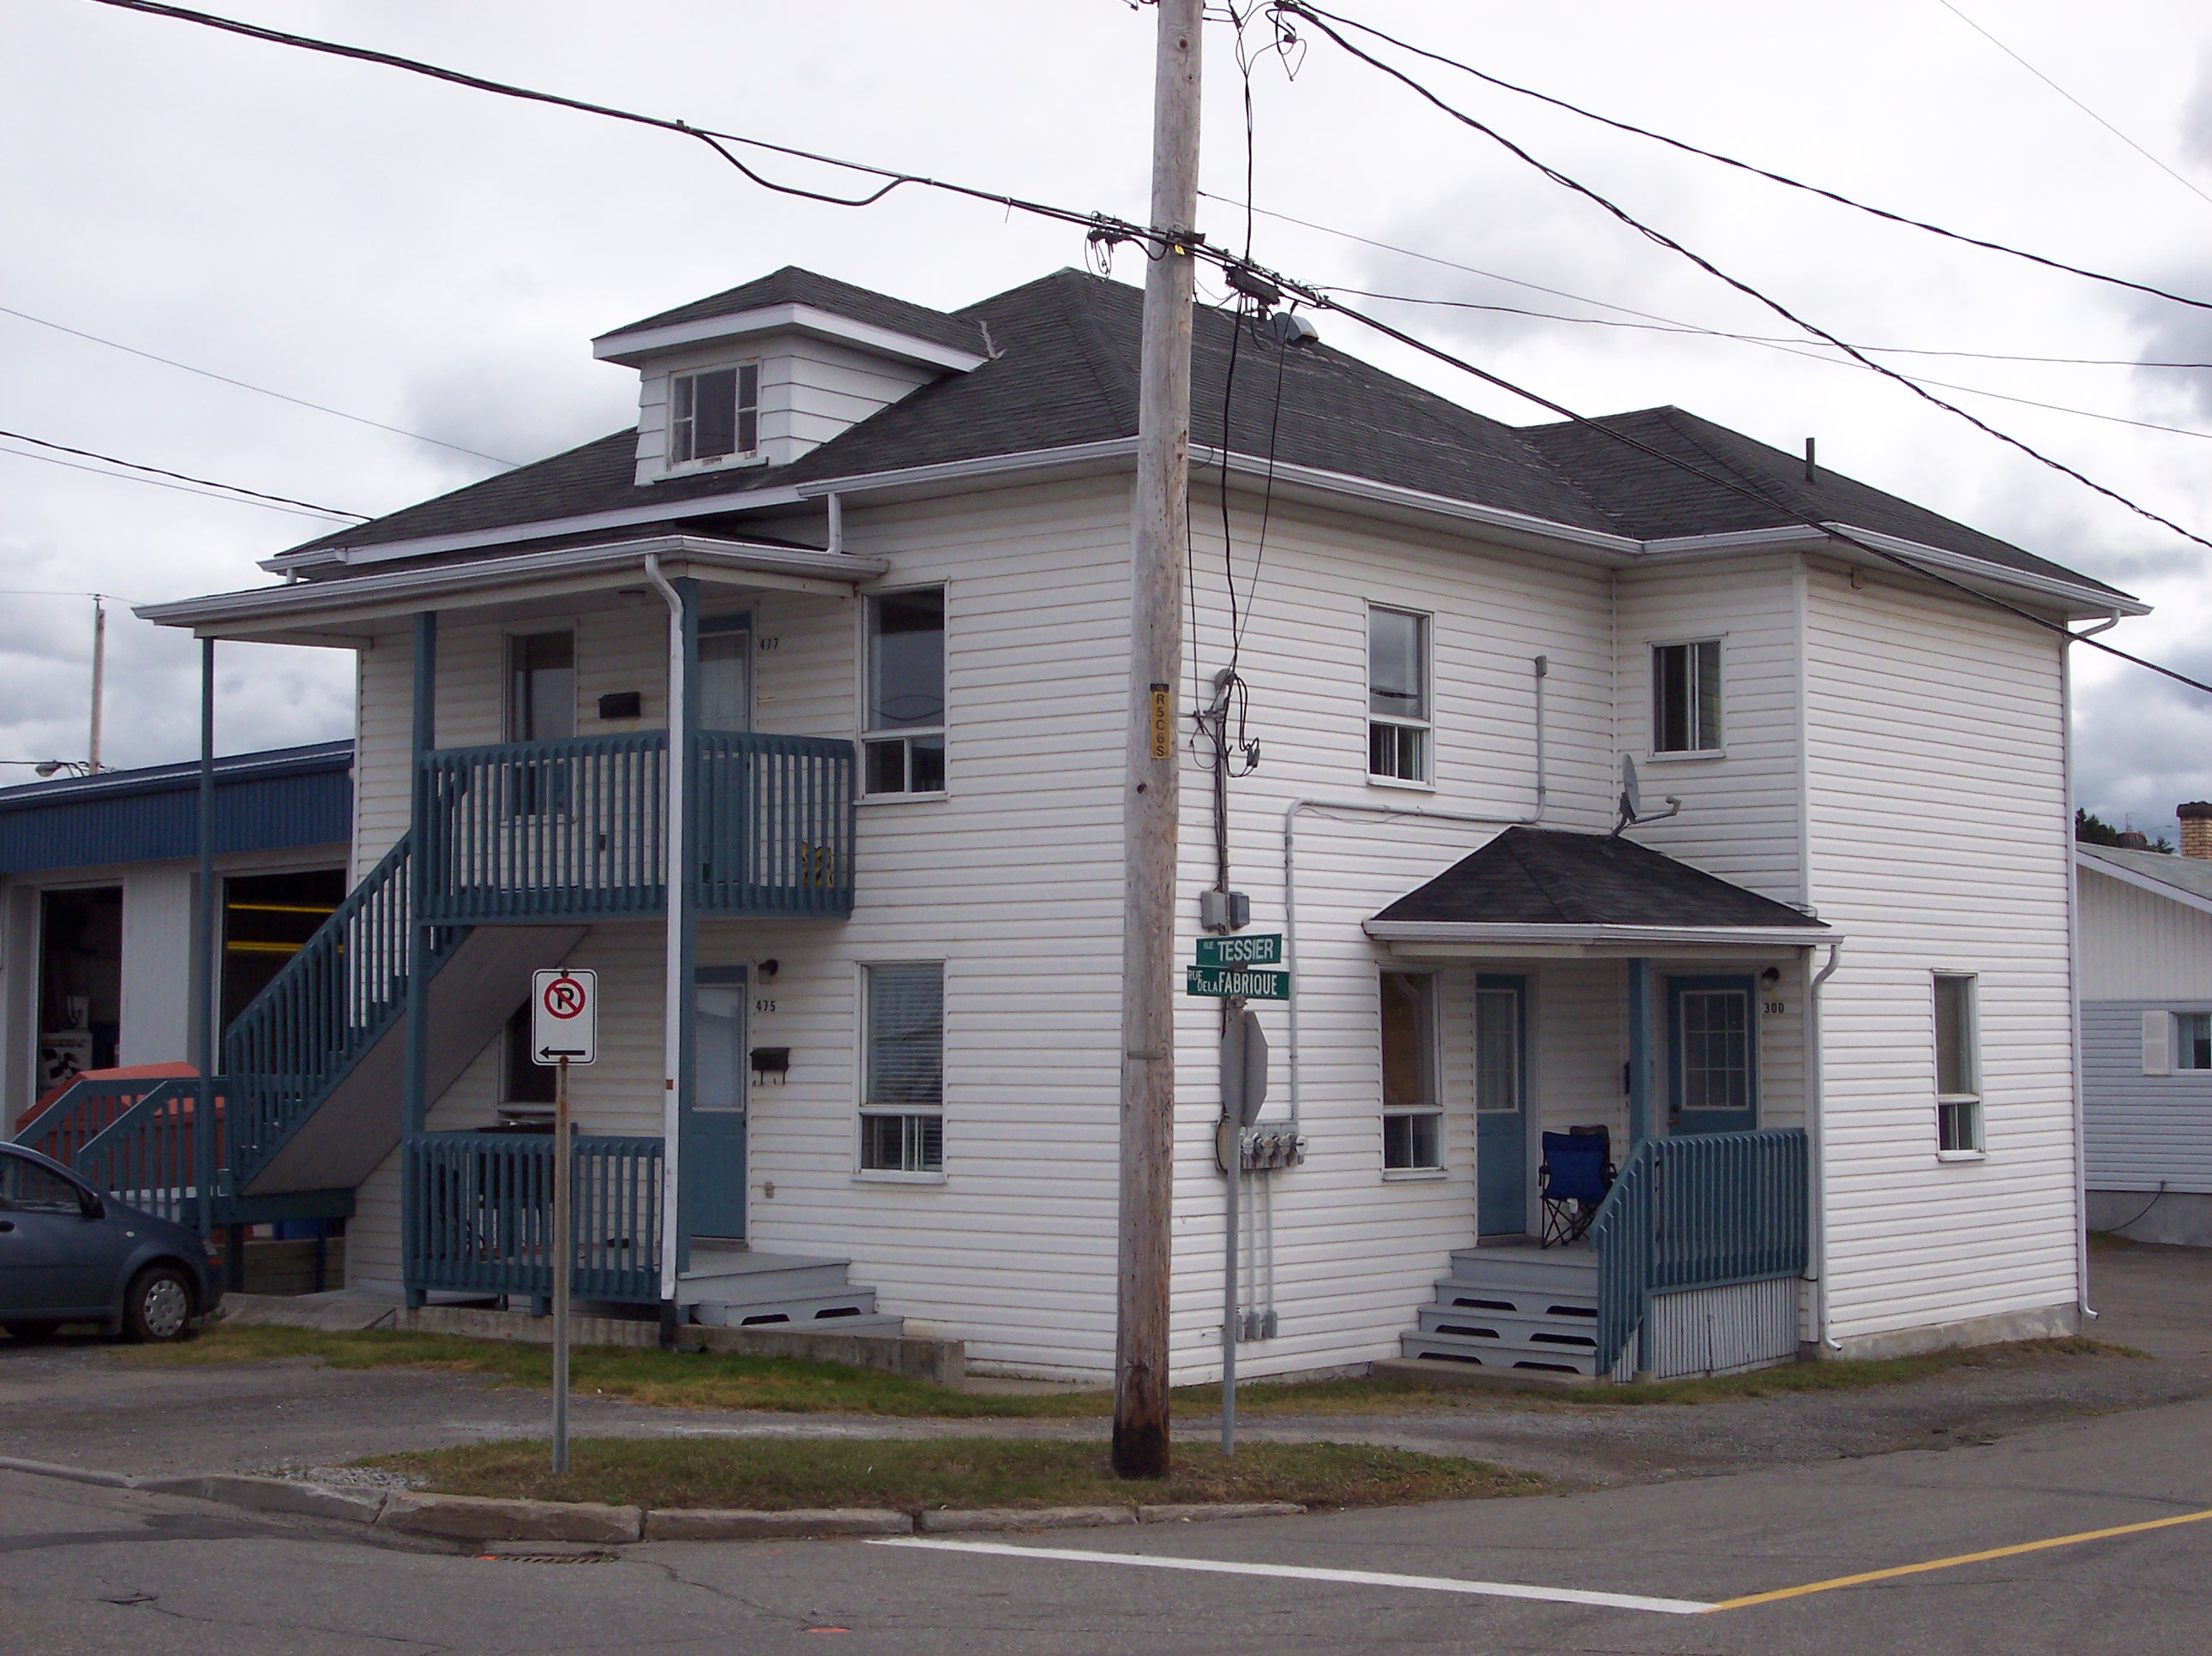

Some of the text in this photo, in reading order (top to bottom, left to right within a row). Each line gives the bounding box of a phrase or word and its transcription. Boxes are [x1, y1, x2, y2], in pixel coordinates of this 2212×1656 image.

[760, 638, 778, 651] 477
[1203, 939, 1274, 962] RUE TESSIER
[1187, 969, 1204, 981] RUE
[1218, 971, 1278, 995] FABRIQUE
[556, 987, 574, 1010] P
[756, 999, 776, 1012] 475
[1763, 1003, 1784, 1013] 300
